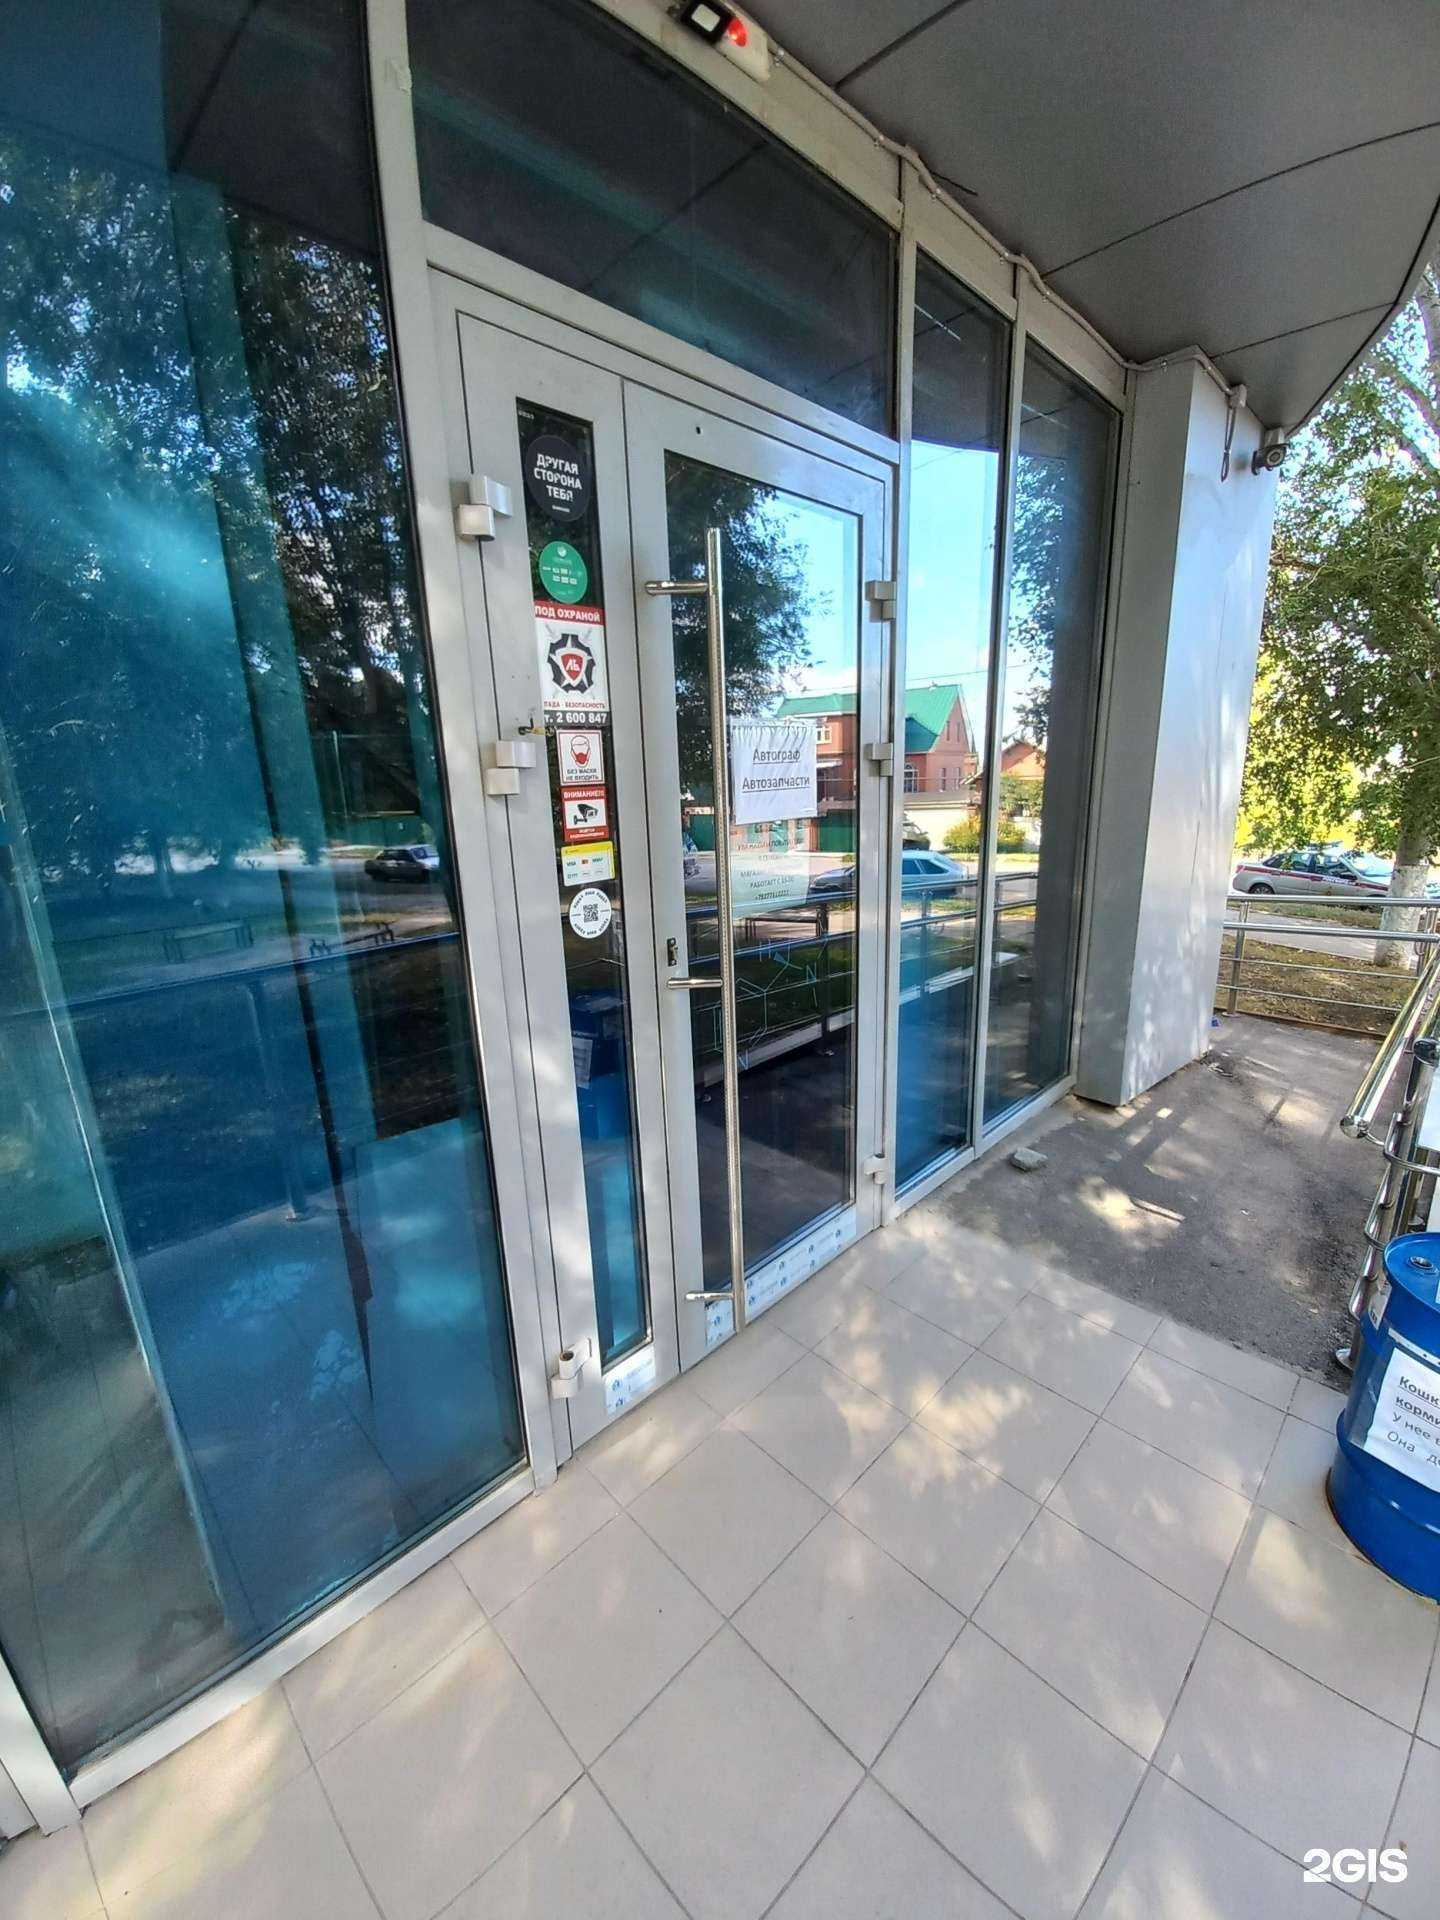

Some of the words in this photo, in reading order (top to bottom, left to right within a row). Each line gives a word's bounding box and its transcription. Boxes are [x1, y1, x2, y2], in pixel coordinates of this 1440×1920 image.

[536, 453, 579, 475] ДРУГАЯ
[533, 467, 583, 490] СТОРОНА
[534, 605, 557, 619] ПОД
[557, 608, 601, 622] ОХРАНОЙ
[565, 701, 606, 709] БЕЗОПАСНОСТЬ
[556, 712, 563, 723] 2
[566, 712, 586, 723] 600
[588, 713, 607, 724] 847
[752, 748, 801, 765] Автограф
[742, 775, 810, 790] Автозапчасти
[1387, 1431, 1416, 1453] Она
